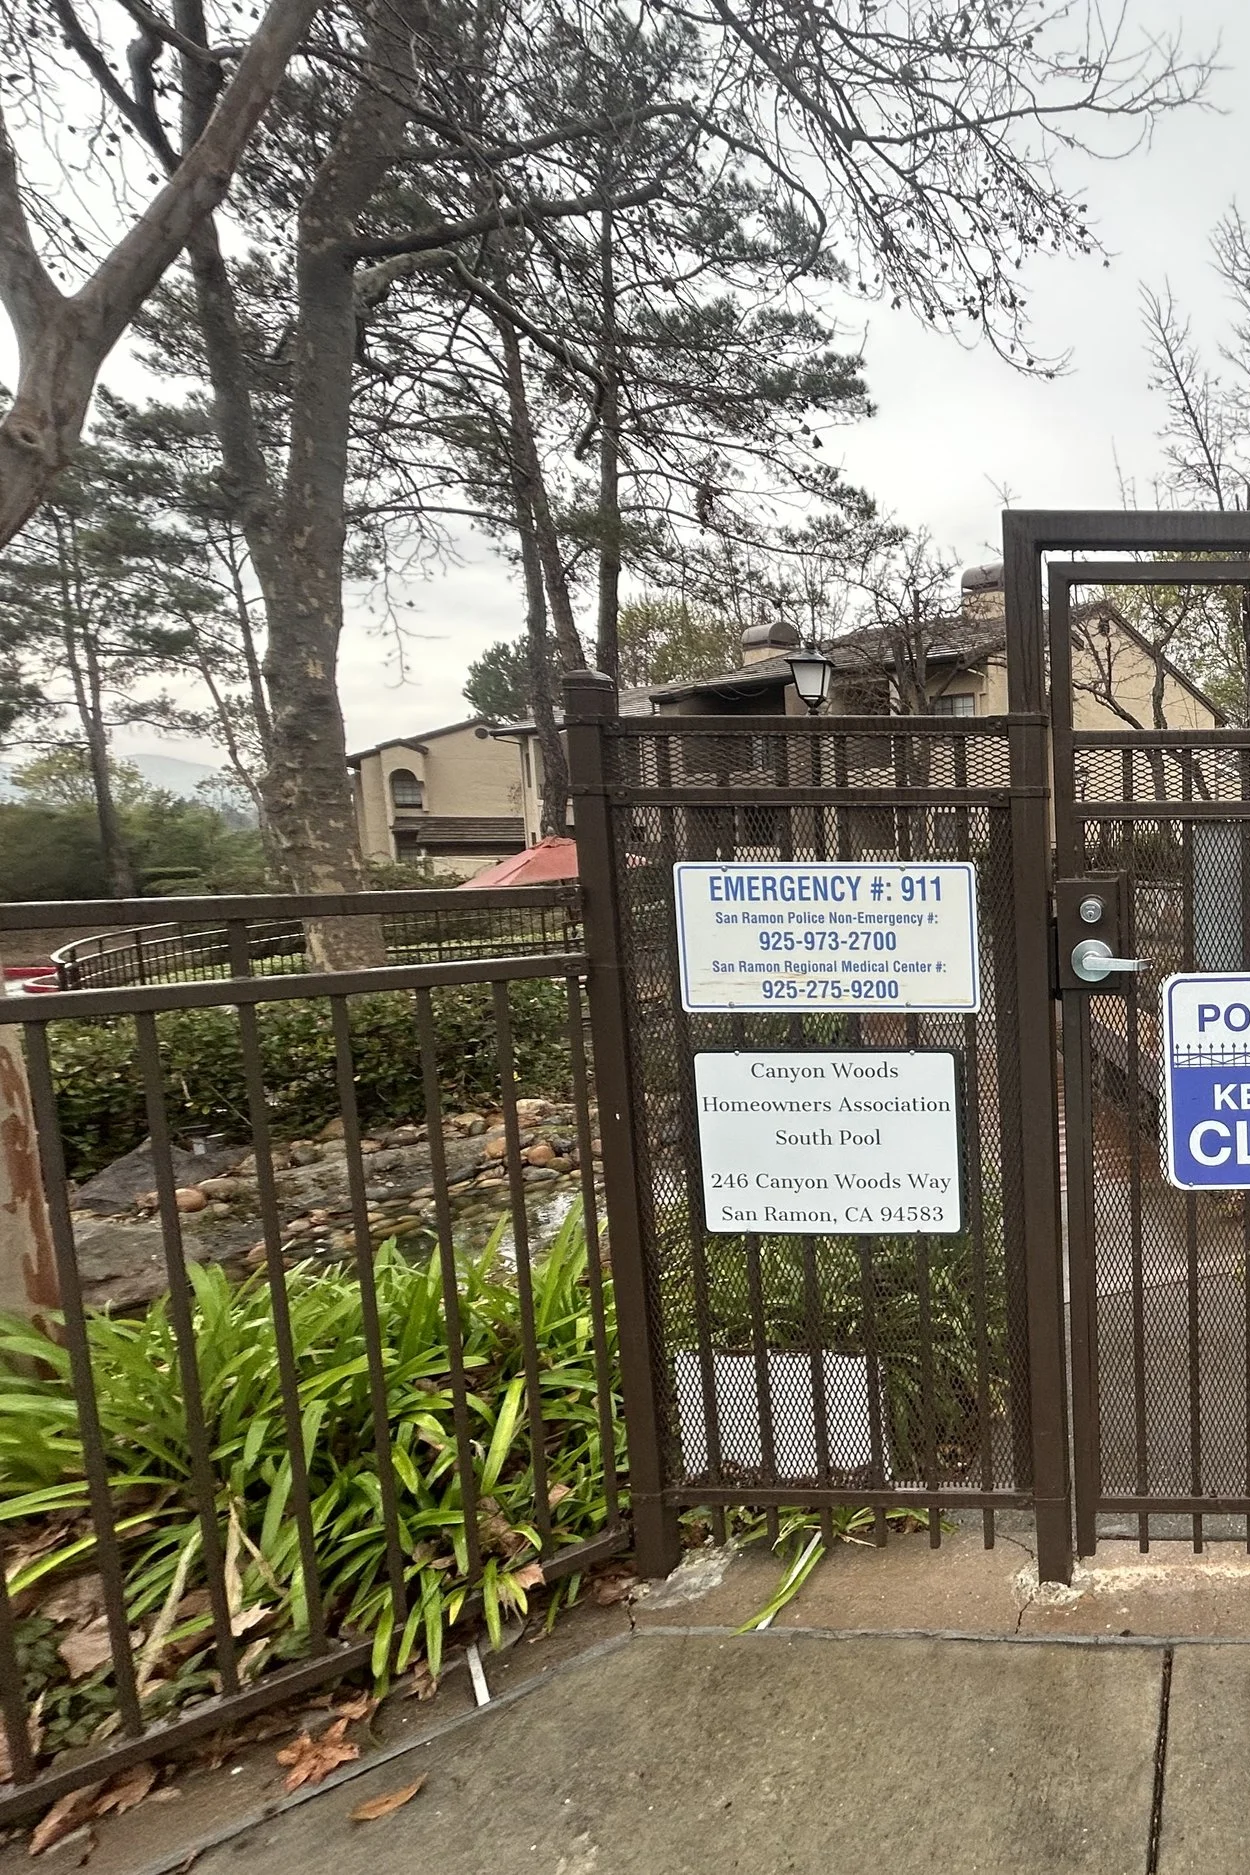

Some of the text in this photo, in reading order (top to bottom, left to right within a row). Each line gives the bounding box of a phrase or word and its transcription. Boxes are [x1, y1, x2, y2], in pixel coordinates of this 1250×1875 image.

[709, 876, 941, 902] EMERGENCY #: 911
[715, 912, 938, 926] San Ramon Police Non-Emergency #:
[759, 931, 896, 950] 925-973-2700
[712, 960, 946, 974] San Ramon Regional Medical Center #:
[762, 980, 898, 999] 925-275-9200
[751, 1061, 898, 1083] Canyon Woods
[703, 1097, 950, 1112] Homeowners Association
[776, 1129, 881, 1145] South Pool
[711, 1172, 951, 1193] 246 Canyon Woods Way
[722, 1206, 943, 1224] San Ramon, CA 94583
